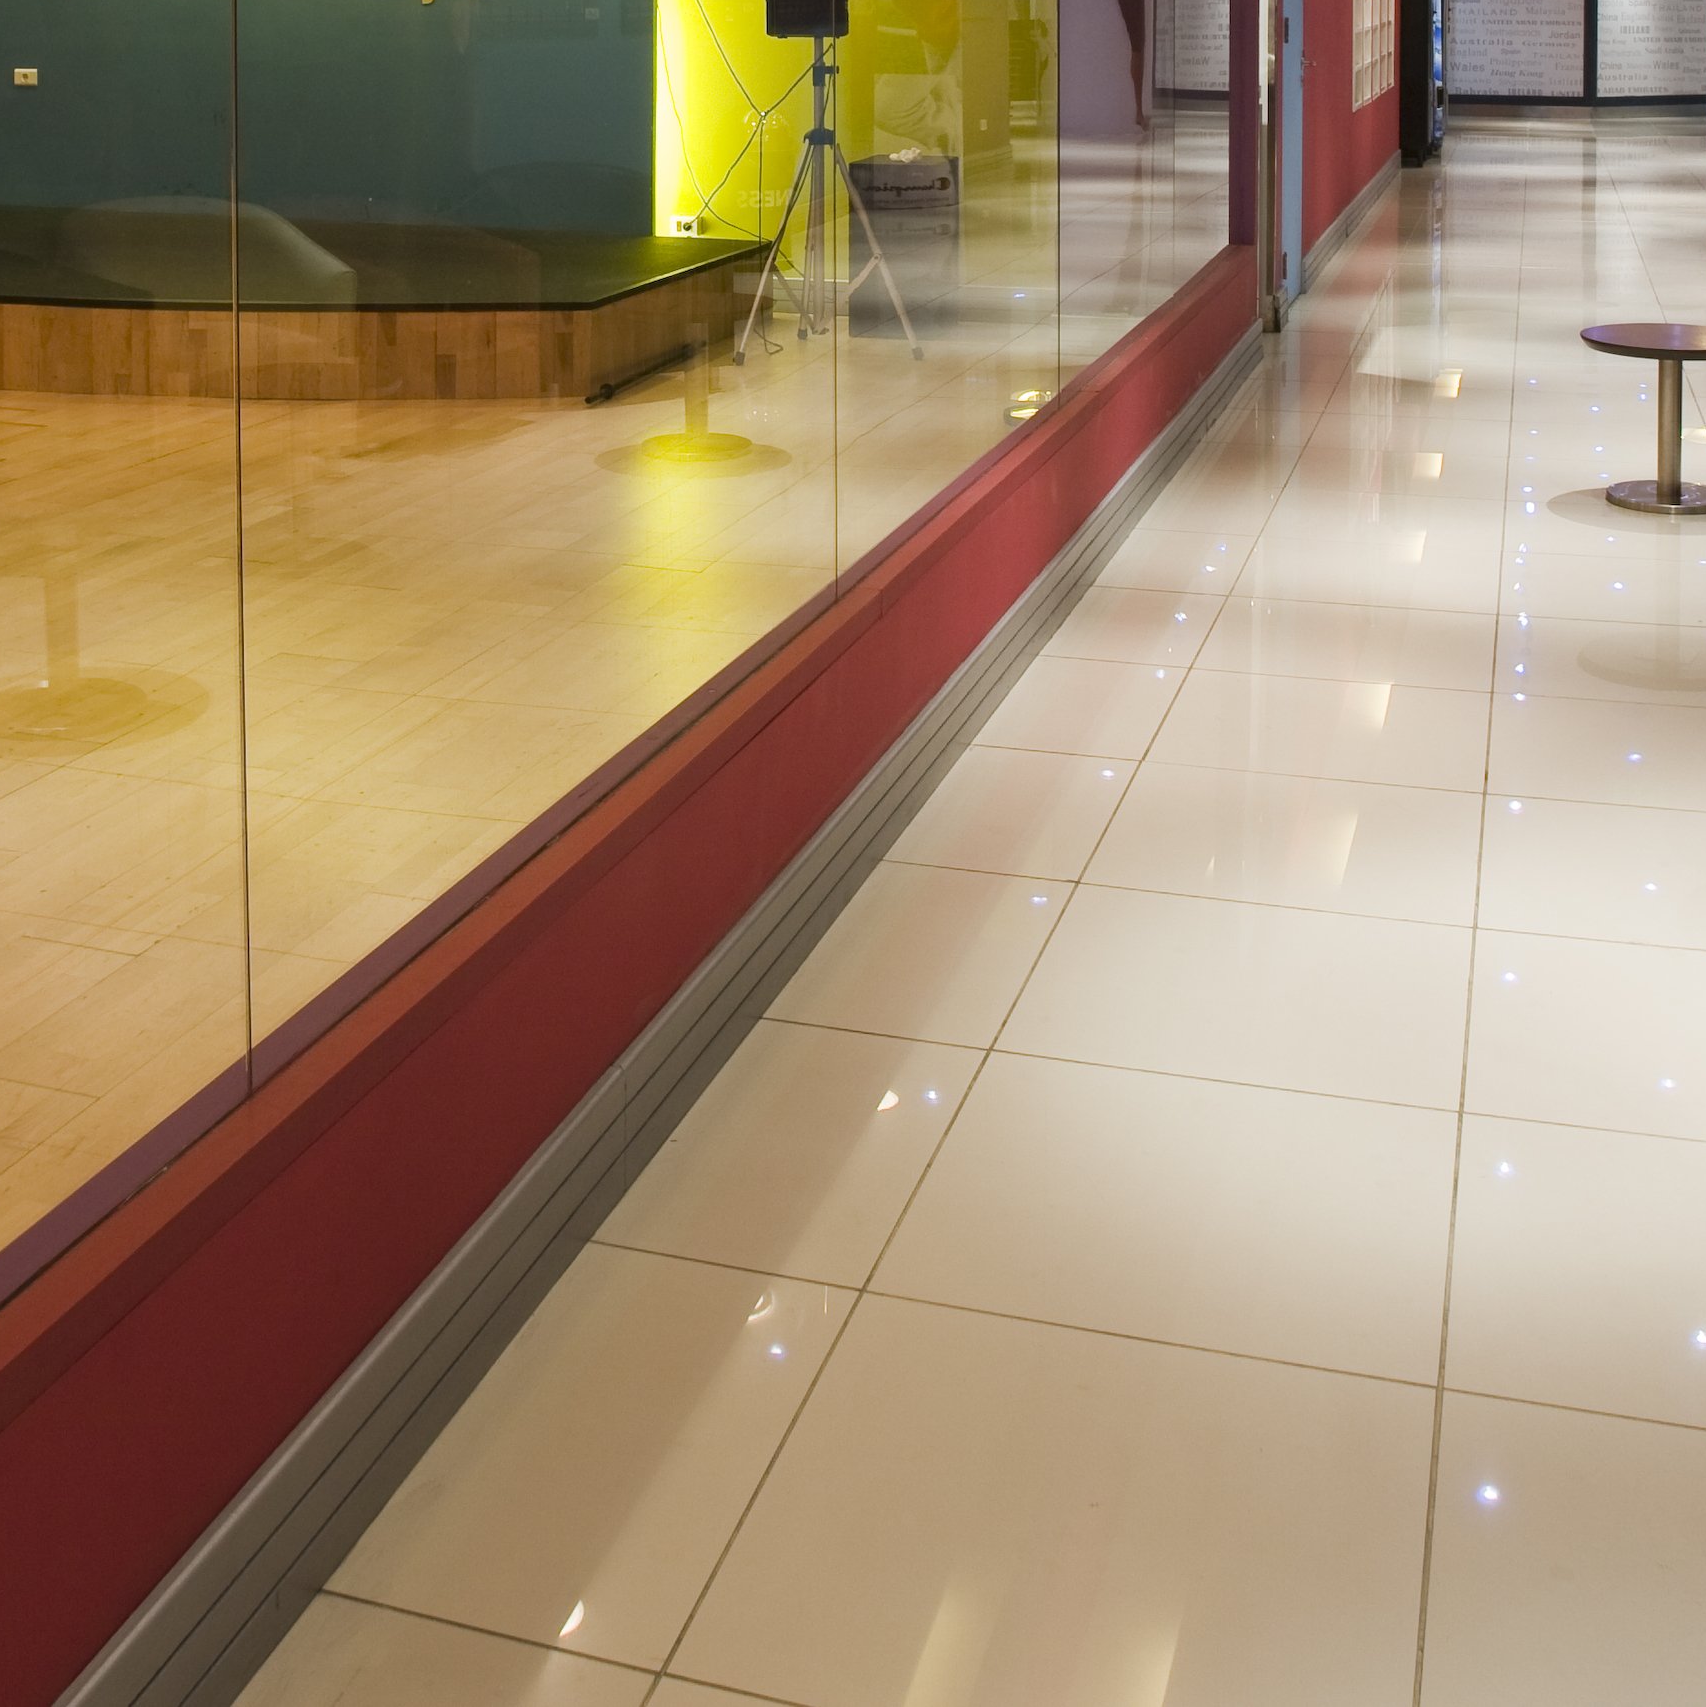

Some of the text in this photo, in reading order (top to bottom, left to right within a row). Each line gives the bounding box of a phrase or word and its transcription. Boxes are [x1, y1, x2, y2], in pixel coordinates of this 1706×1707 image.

[1548, 30, 1581, 39] Jordan
[1449, 37, 1513, 45] Australia
[1449, 61, 1485, 72] Wales
[1600, 61, 1623, 70] China
[1653, 60, 1680, 70] Wales
[1598, 73, 1648, 81] Australia
